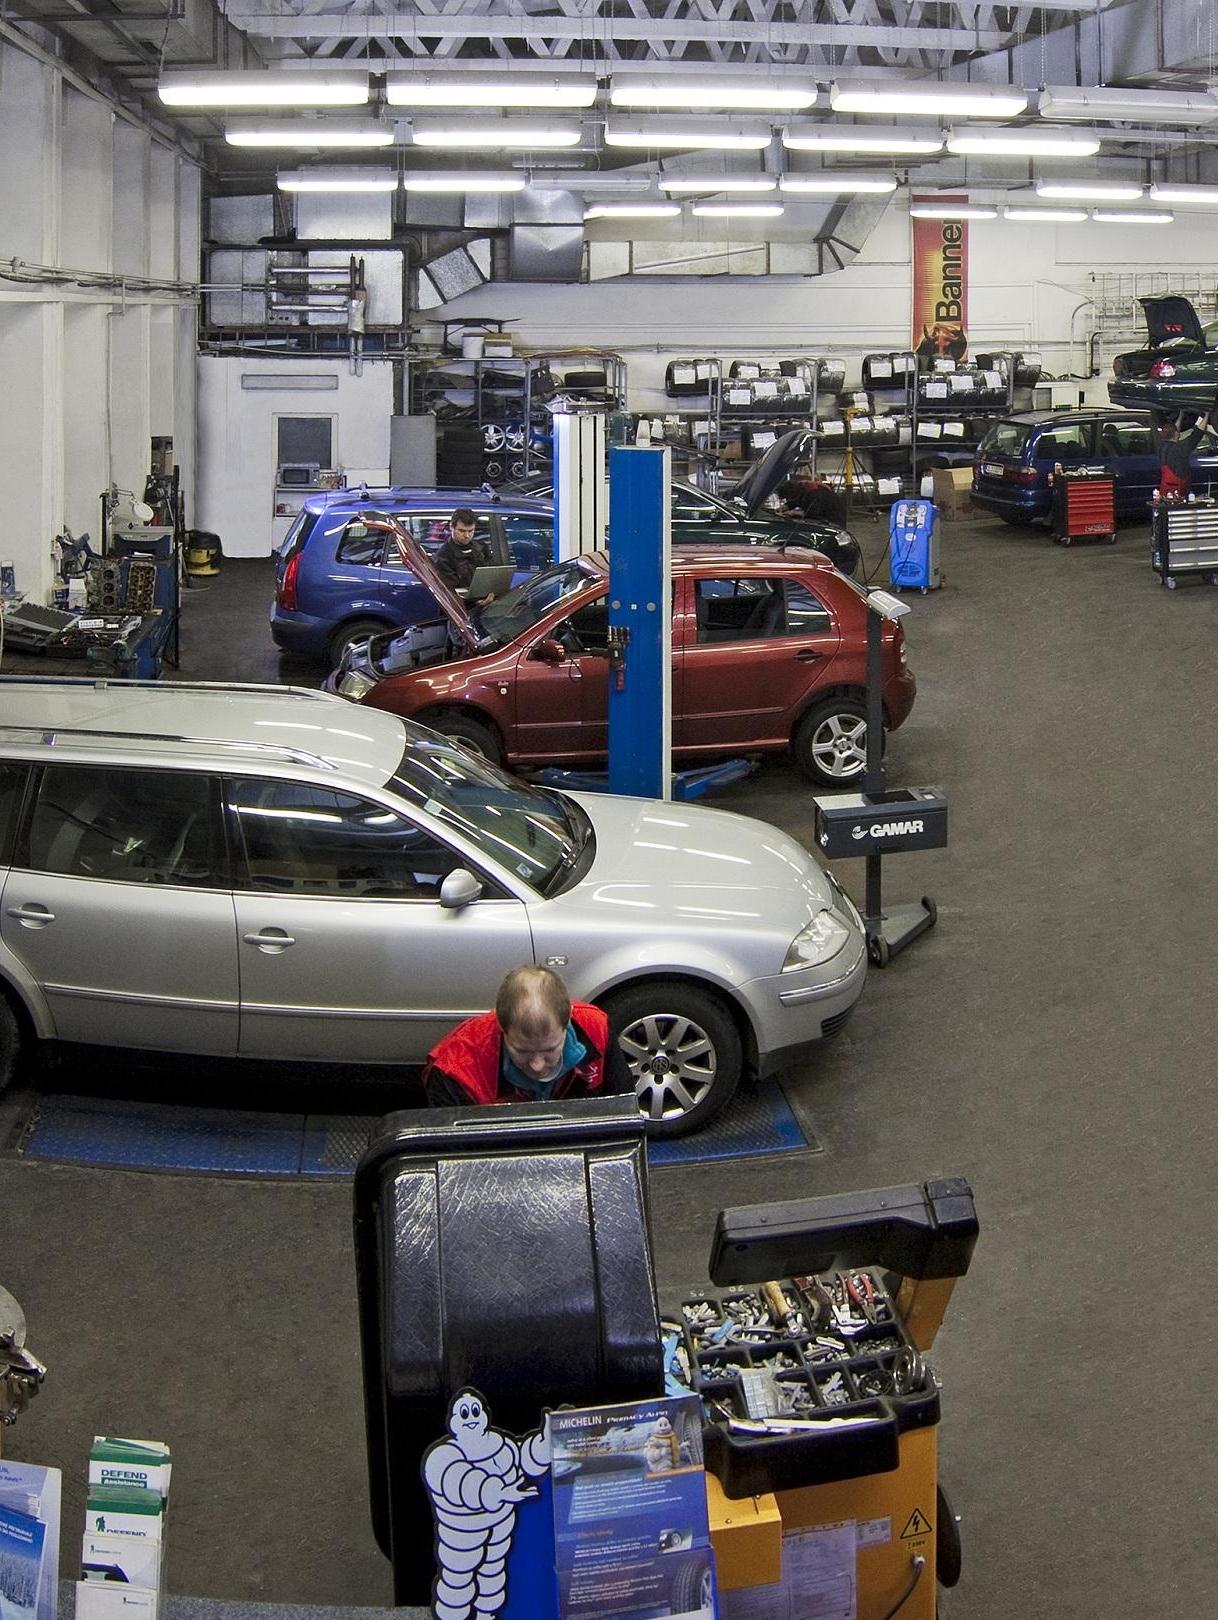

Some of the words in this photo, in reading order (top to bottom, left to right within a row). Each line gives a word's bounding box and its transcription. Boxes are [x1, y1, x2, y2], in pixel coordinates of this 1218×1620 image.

[870, 820, 924, 838] GAMAR
[559, 1415, 602, 1429] MICHELIN
[101, 1469, 148, 1480] DEFEND
[103, 1478, 146, 1488] Assistance
